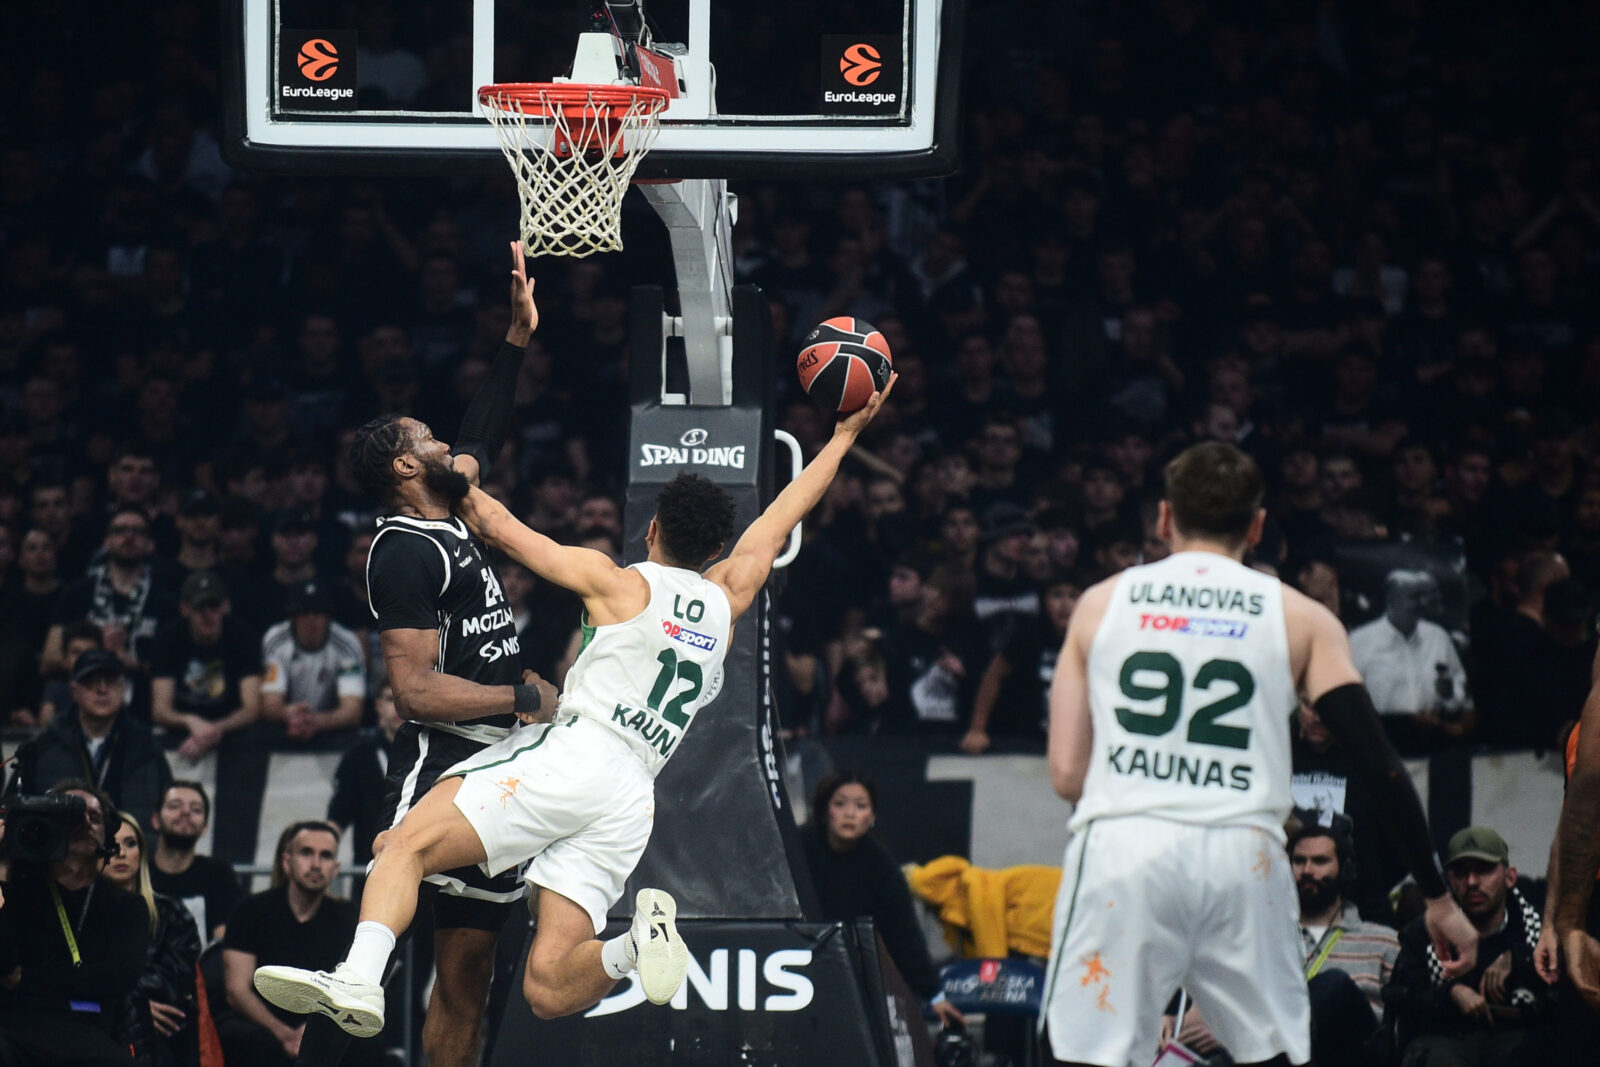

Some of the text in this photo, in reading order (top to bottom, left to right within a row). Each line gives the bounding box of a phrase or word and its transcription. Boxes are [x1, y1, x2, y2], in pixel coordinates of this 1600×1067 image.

[282, 85, 354, 101] EuroLeague
[824, 91, 896, 106] EuroLeague
[640, 443, 745, 469] SPALDING
[673, 593, 705, 623] LO
[1129, 582, 1265, 616] ULANOVAS
[647, 647, 704, 731] 12
[1114, 651, 1255, 750] 92
[611, 703, 677, 759] KAUN
[1108, 745, 1253, 791] KAUNAS
